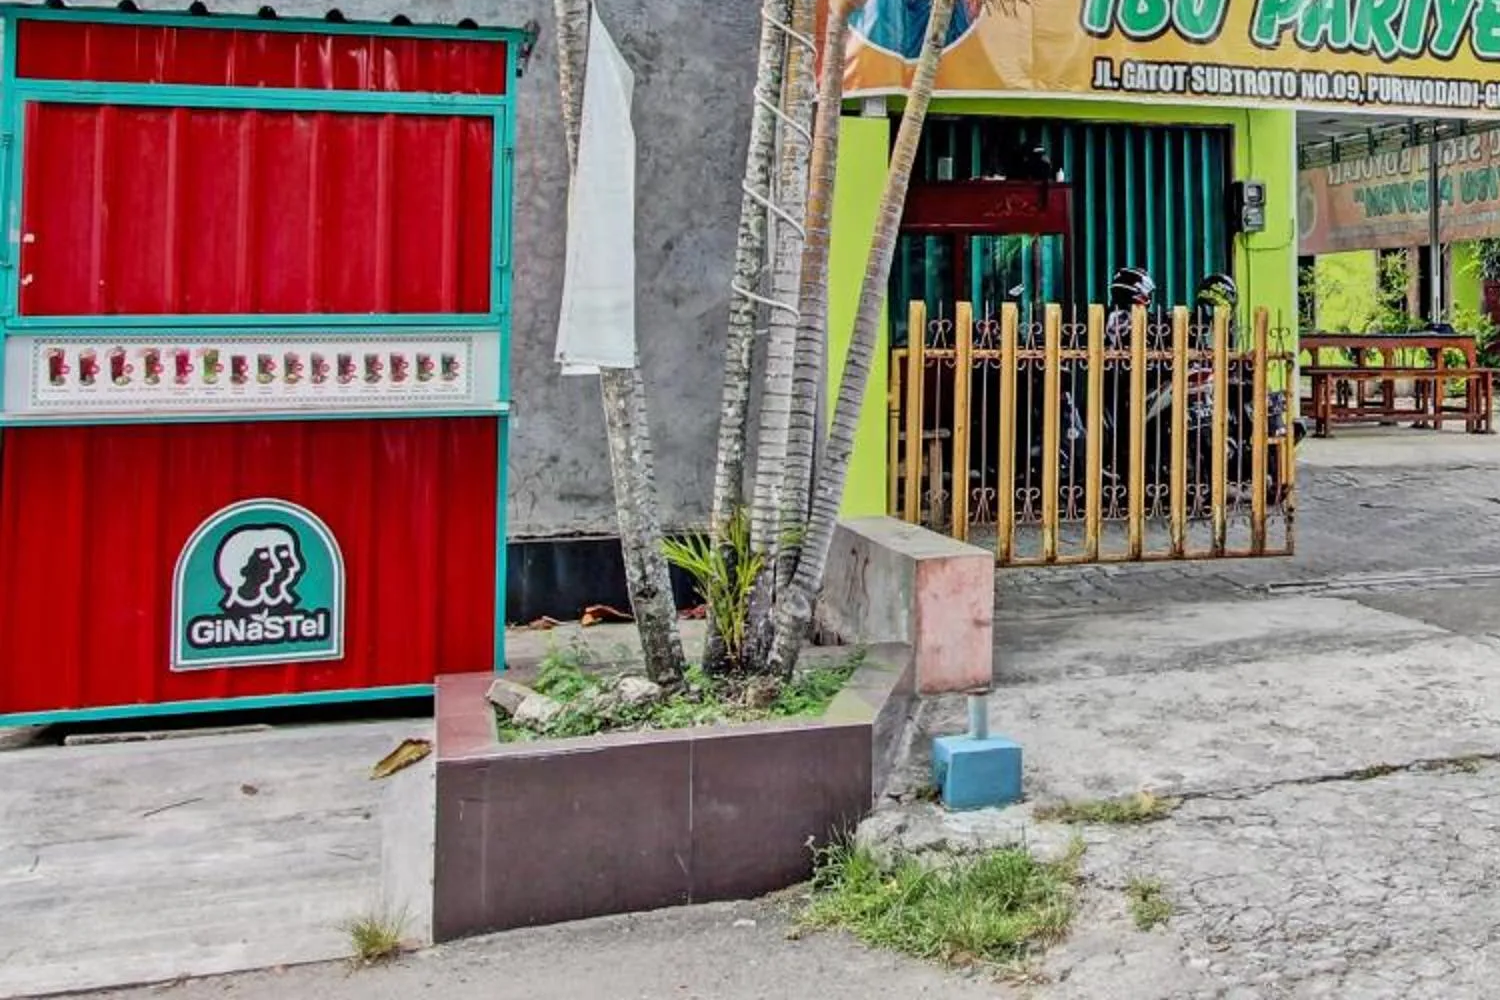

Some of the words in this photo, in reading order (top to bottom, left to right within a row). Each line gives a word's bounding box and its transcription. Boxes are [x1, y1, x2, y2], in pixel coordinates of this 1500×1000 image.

[1121, 60, 1188, 93] GATOT
[1189, 64, 1297, 99] SUBTROTO
[1299, 71, 1365, 105] NO.09,
